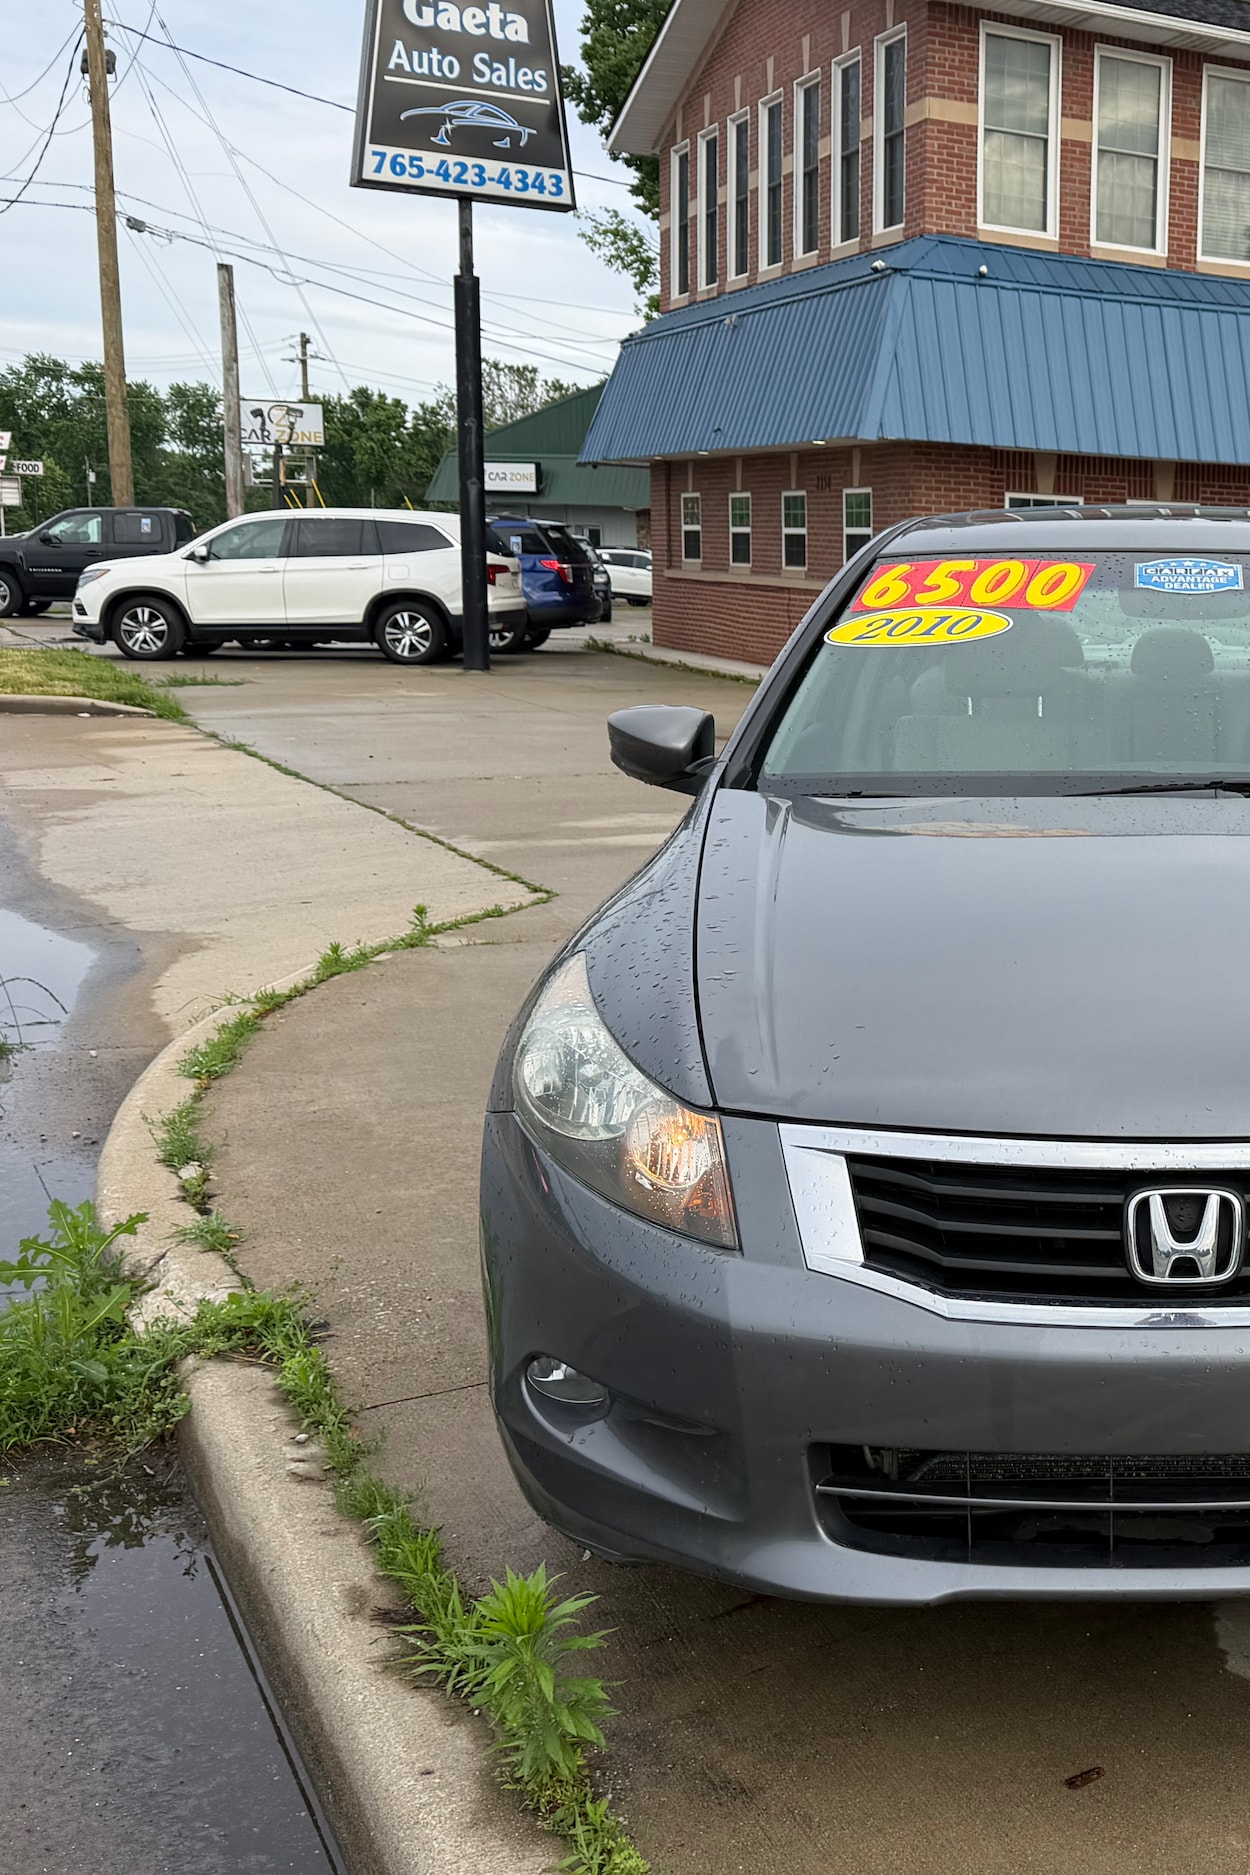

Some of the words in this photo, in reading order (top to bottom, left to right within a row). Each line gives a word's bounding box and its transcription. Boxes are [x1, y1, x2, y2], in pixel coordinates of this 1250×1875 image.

[402, 0, 530, 44] Gaeta
[387, 39, 460, 79] Auto
[472, 52, 548, 92] Sales
[371, 150, 564, 197] 765-423-4343
[276, 429, 322, 443] ZONE
[16, 463, 40, 473] FOOD
[488, 471, 507, 481] CAR
[509, 472, 535, 482] ZONE
[1143, 567, 1234, 577] CARFAX
[861, 559, 1087, 608] 6500
[1151, 575, 1228, 584] ADVANTAGE
[1164, 582, 1215, 590] DEALER
[851, 613, 983, 641] 2010
